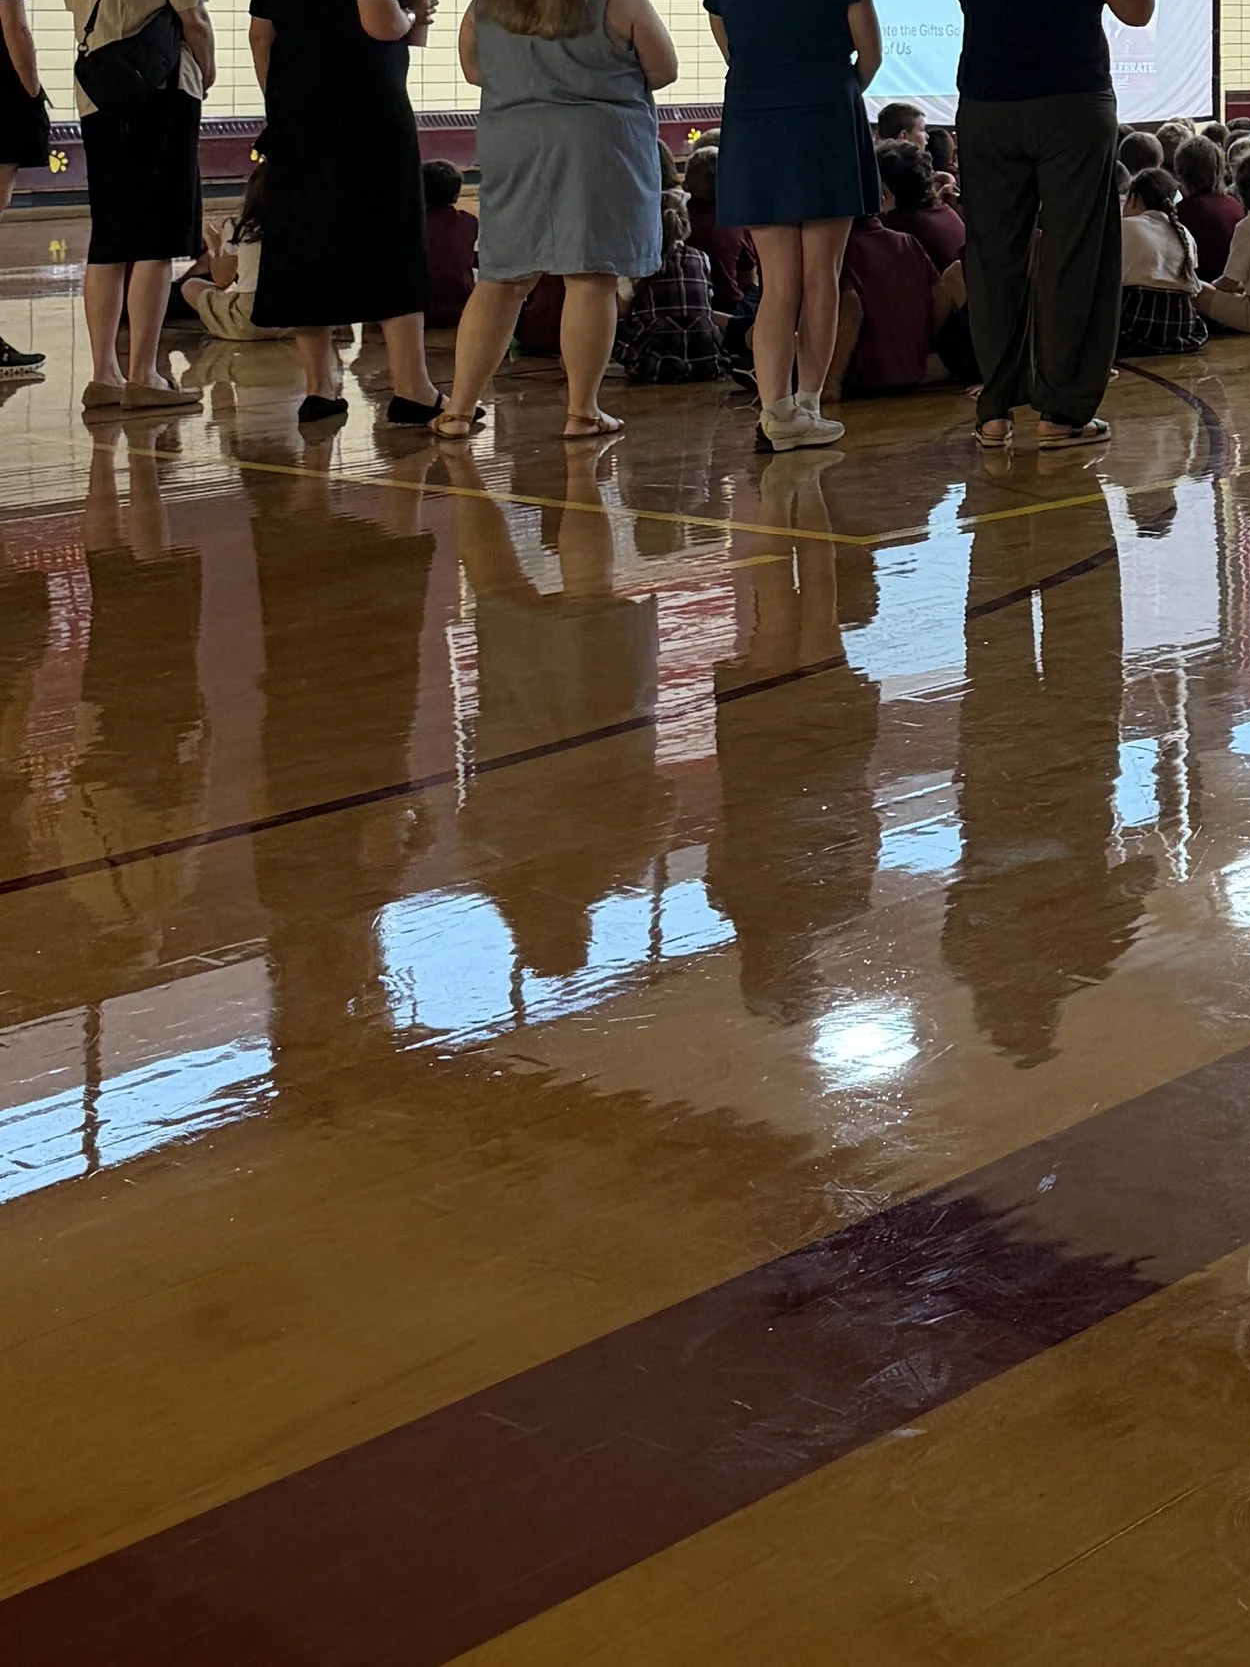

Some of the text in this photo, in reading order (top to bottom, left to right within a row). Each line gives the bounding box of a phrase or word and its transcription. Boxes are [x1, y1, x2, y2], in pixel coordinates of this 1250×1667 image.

[900, 25, 916, 36] the
[919, 24, 944, 36] Gifts
[896, 43, 912, 55] Us
